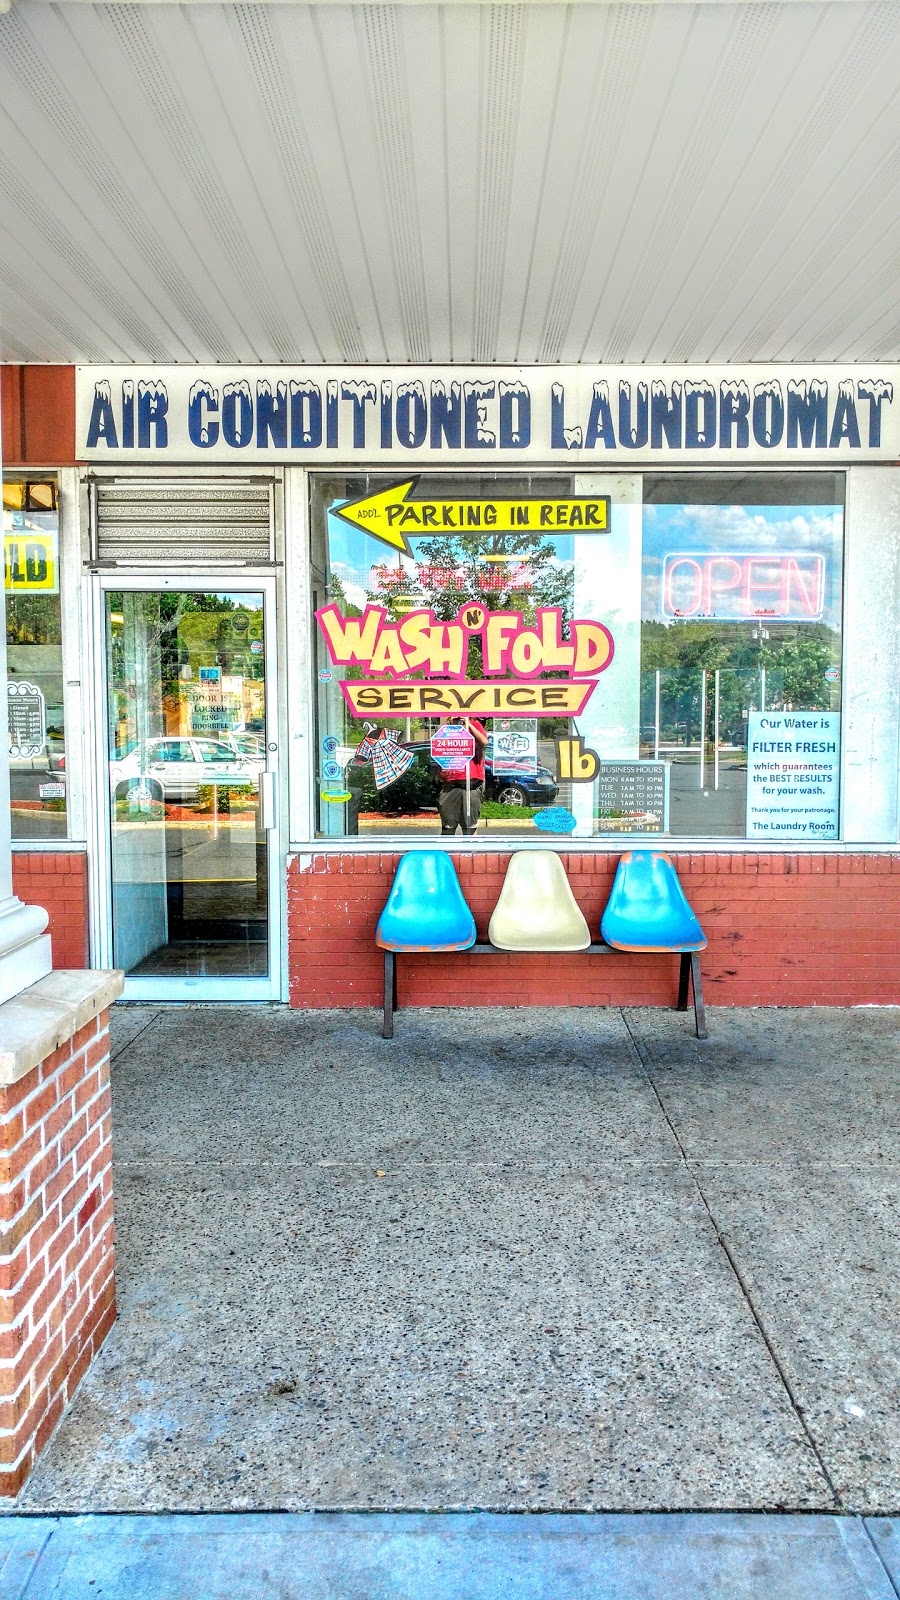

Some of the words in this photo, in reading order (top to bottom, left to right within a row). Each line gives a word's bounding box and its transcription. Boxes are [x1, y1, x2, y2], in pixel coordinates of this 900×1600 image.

[86, 379, 169, 449] AIR
[188, 379, 531, 449] CONDITIONED
[551, 379, 893, 450] LAUNDROMAT
[385, 503, 498, 527] PARKING
[510, 505, 530, 526] IN
[540, 504, 602, 526] REAR
[4, 543, 47, 582] LD
[666, 557, 823, 617] OPEN
[319, 607, 464, 675] WASH
[486, 607, 611, 675] FOLD
[193, 694, 217, 702] DOOR
[356, 687, 568, 710] SERVICE
[194, 705, 228, 713] LOCKED
[760, 718, 781, 729] Our
[784, 718, 818, 728] Water
[820, 718, 830, 728] is
[437, 739, 446, 747] 24
[447, 739, 469, 747] HOUR
[752, 742, 793, 753] FILTER
[795, 742, 836, 753] FRESH
[754, 762, 780, 771] which
[782, 763, 833, 773] guarantees
[753, 774, 768, 782] the
[769, 774, 791, 782] BEST
[793, 774, 832, 782] RESULTS
[762, 787, 775, 795] for
[777, 788, 798, 796] your
[799, 787, 826, 795] wash.
[752, 822, 769, 830] The
[770, 822, 807, 831] Laundry
[809, 822, 835, 830] Room
